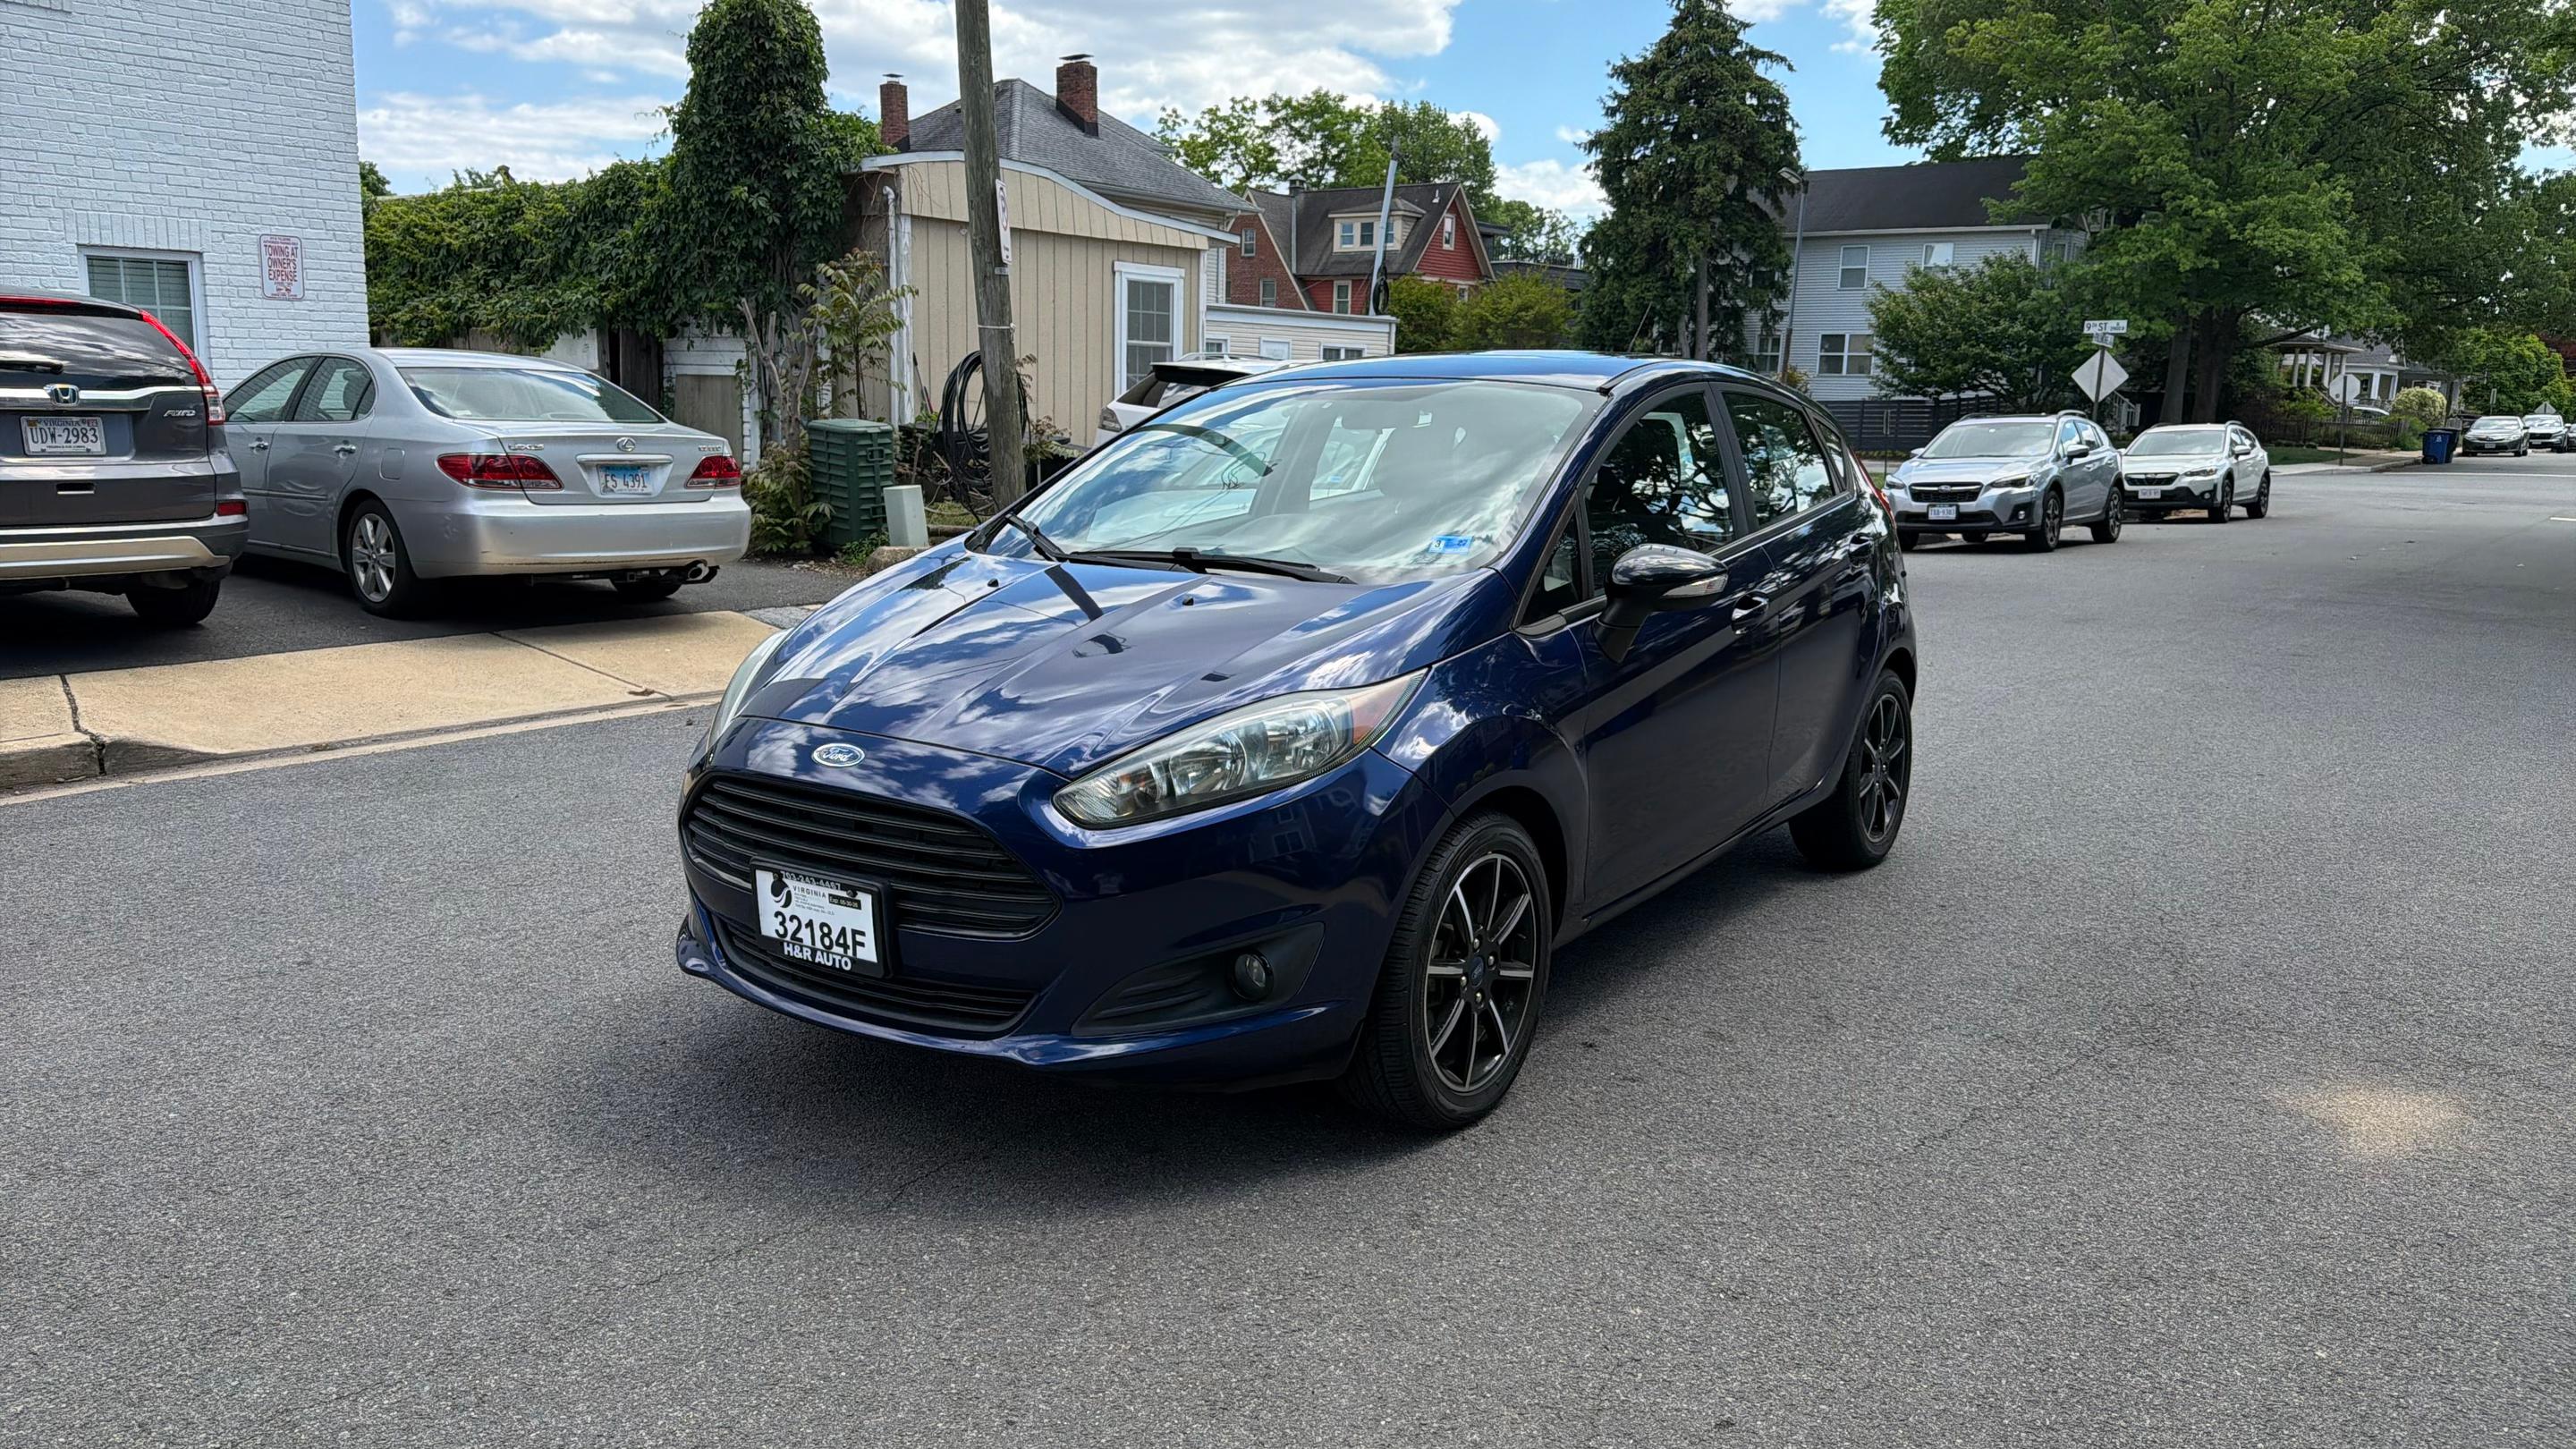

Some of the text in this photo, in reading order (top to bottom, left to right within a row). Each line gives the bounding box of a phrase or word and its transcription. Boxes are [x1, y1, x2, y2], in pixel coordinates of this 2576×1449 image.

[264, 244, 299, 258] TOWING AT
[267, 257, 297, 270] OWNER'S
[268, 269, 298, 282] EXPENSE
[2098, 323, 2108, 331] ST
[43, 419, 81, 427] VIRGINIA
[30, 427, 98, 445] UDW-2983
[623, 473, 648, 488] 4391
[822, 746, 854, 762] Ford
[792, 885, 827, 899] VIRGINIA
[774, 911, 867, 958] 32184F
[783, 942, 852, 971] H&R AUTO
